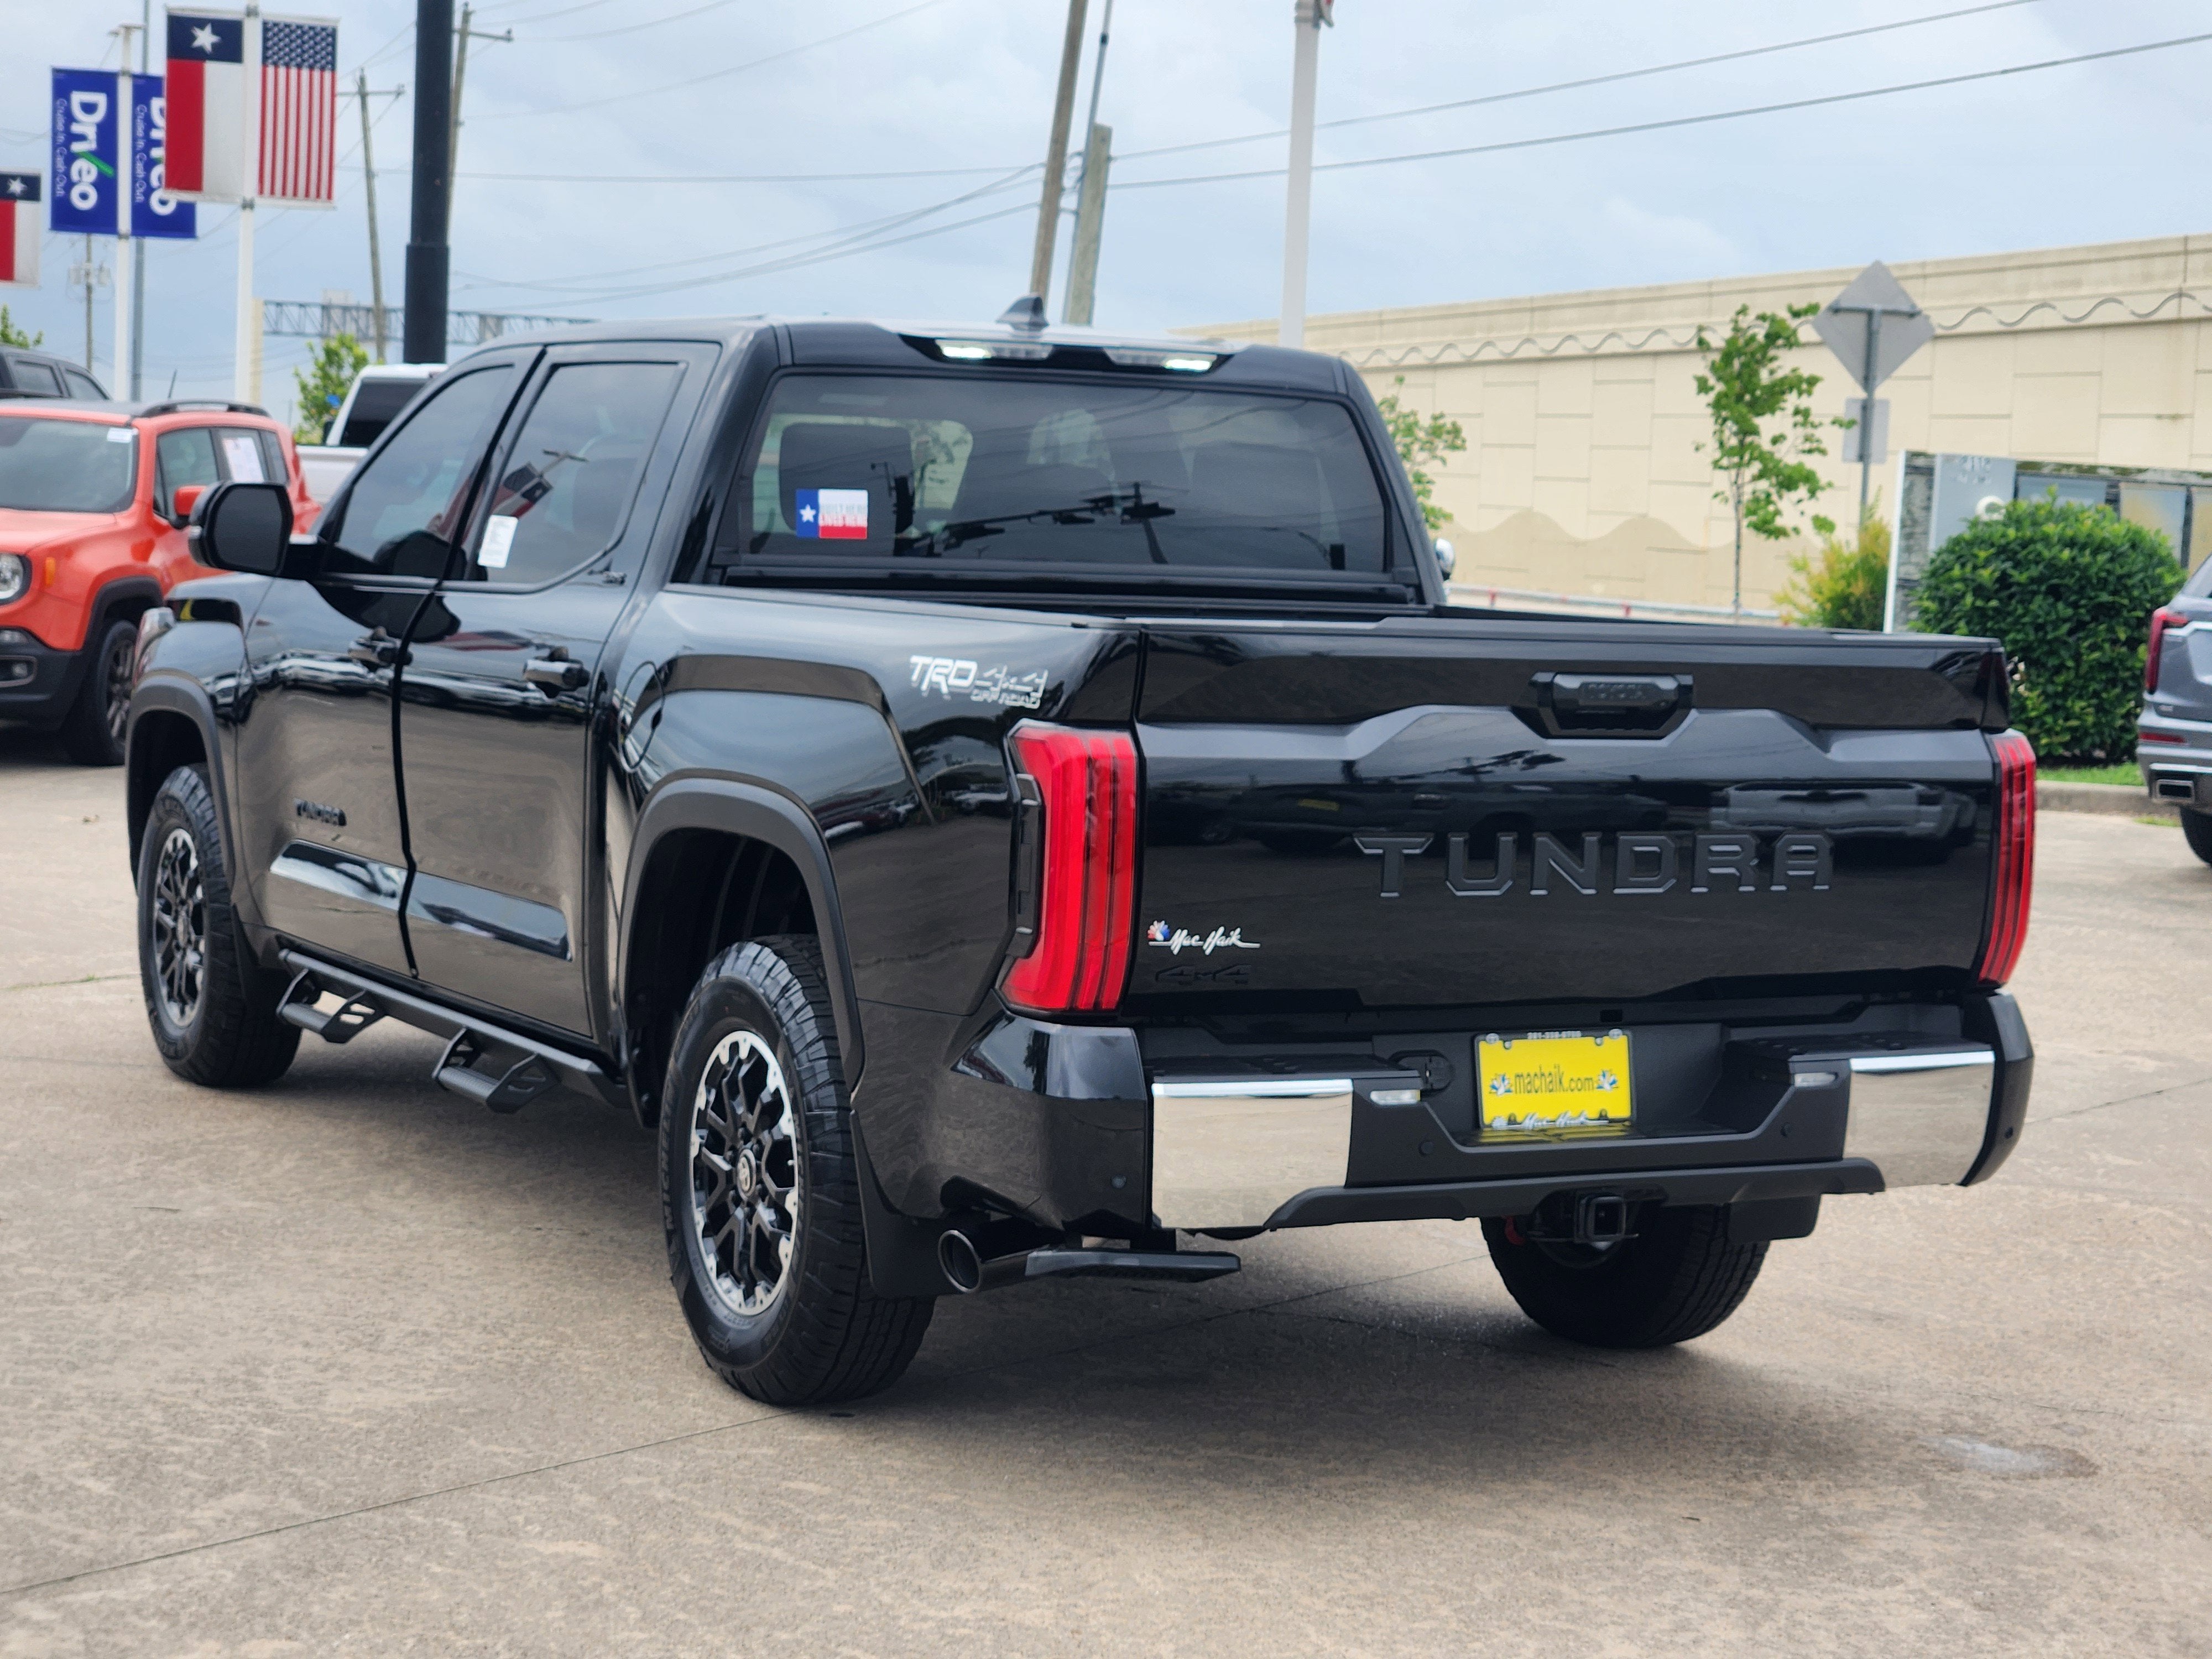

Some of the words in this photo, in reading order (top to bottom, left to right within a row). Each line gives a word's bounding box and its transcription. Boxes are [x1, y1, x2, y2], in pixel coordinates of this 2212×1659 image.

[910, 655, 978, 695] TRD
[1353, 831, 1834, 897] TUNDRA
[1514, 1063, 1594, 1094] machaik.com
